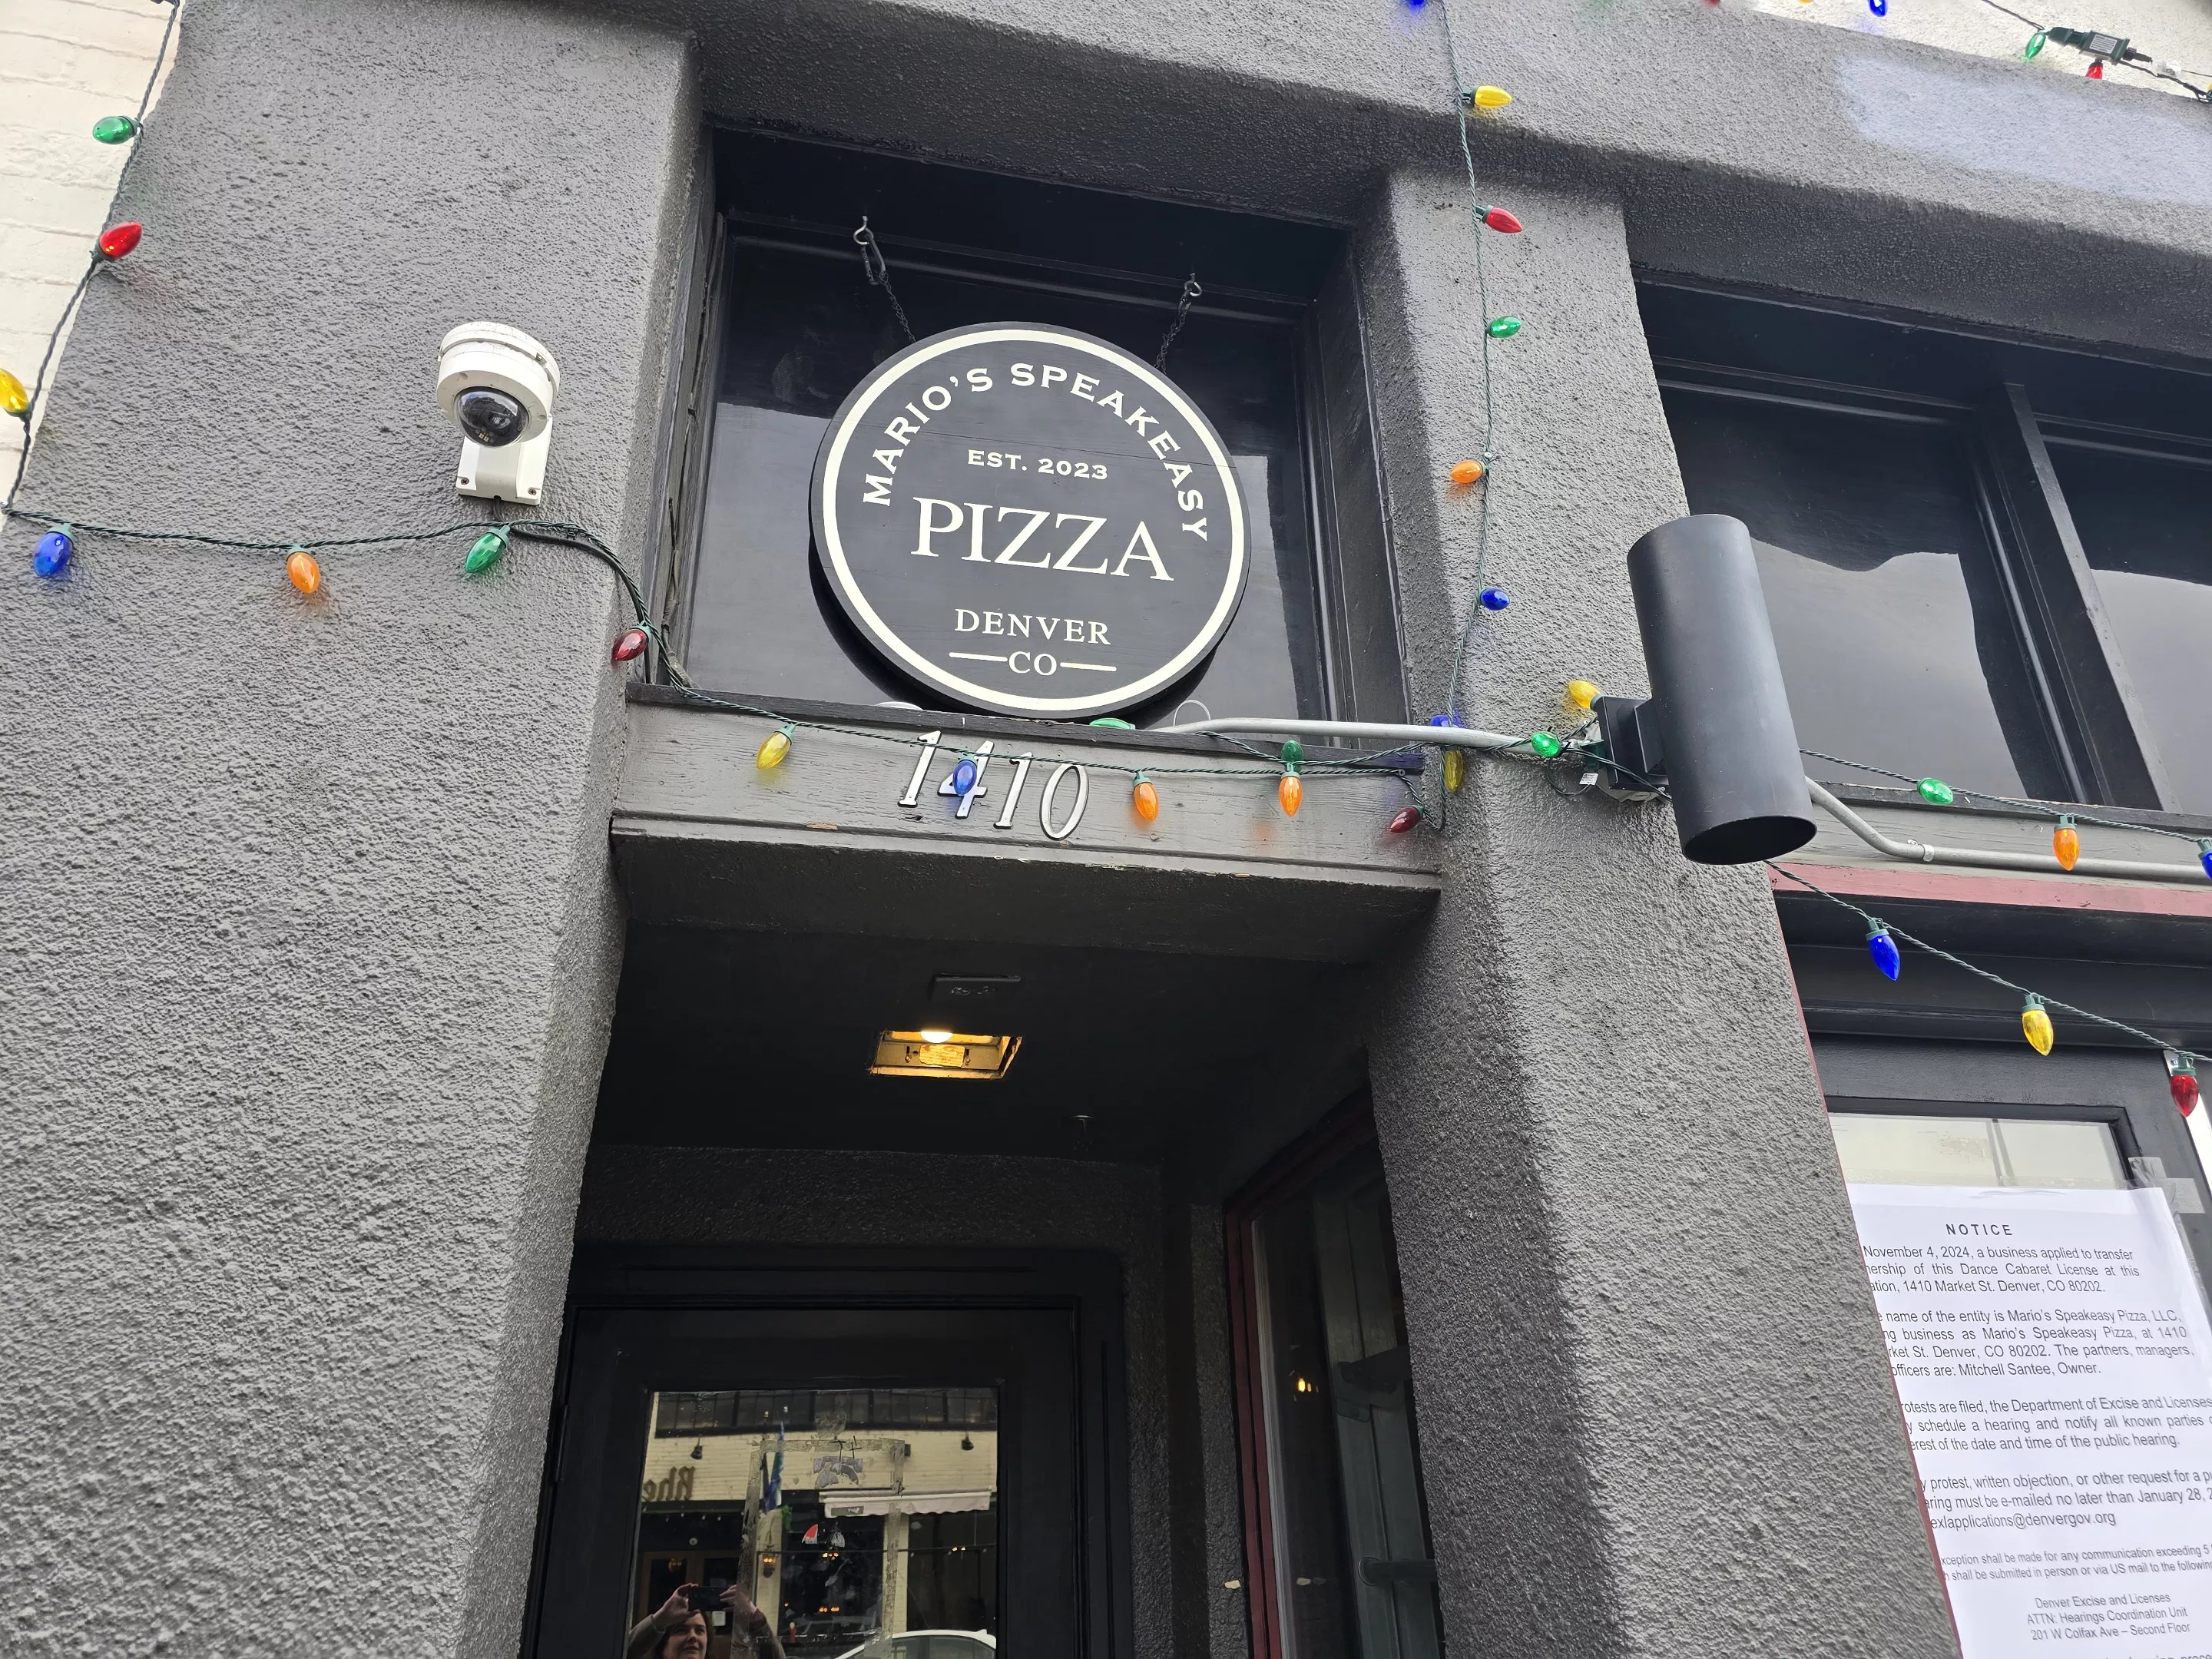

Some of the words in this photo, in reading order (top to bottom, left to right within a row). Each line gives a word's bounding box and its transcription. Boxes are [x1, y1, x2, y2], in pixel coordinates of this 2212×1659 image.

[863, 366, 993, 507] MARIO'S
[1010, 363, 1208, 542] SPEAKEASY
[967, 449, 1028, 471] EST.
[1038, 458, 1108, 480] 2023
[910, 496, 1174, 581] PIZZA
[954, 608, 1112, 645] DENVER
[1008, 651, 1058, 677] CO
[898, 730, 1090, 840] 1410
[1945, 1224, 2012, 1236] NOTICE
[1863, 1246, 1922, 1257] November
[1926, 1246, 1939, 1259] 4,
[1941, 1246, 1974, 1259] 2024,
[1976, 1249, 1985, 1258] a
[1987, 1247, 2038, 1259] business
[2040, 1247, 2079, 1260] applied
[2081, 1248, 2092, 1260] to
[2094, 1248, 2133, 1260] transfer
[1913, 1263, 1924, 1275] of
[1932, 1263, 1953, 1275] this
[1960, 1263, 1998, 1275] Dance
[2005, 1263, 2051, 1275] Cabaret
[2056, 1263, 2098, 1276] License
[2104, 1266, 2116, 1277] at
[2120, 1265, 2140, 1277] this
[1903, 1280, 1932, 1292] 1410
[1935, 1280, 1975, 1292] Market
[1979, 1280, 1995, 1292] St.
[1998, 1280, 2045, 1293] Denver,
[2047, 1280, 2065, 1292] CO
[2068, 1280, 2105, 1292] 80202.
[1886, 1312, 1918, 1322] name
[1922, 1310, 1932, 1322] of
[1936, 1310, 1955, 1322] the
[1959, 1310, 1990, 1324] entity
[1994, 1310, 2005, 1322] is
[2007, 1310, 2051, 1321] Mario's
[2055, 1310, 2114, 1323] Speakeasy
[2117, 1310, 2151, 1323] Pizza,
[2151, 1310, 2182, 1322] LLC,
[1902, 1328, 1954, 1340] business
[1962, 1330, 1976, 1340] as
[1982, 1327, 2026, 1339] Mario's
[2032, 1326, 2097, 1341] Speakeasy
[2103, 1326, 2137, 1339] Pizza,
[2141, 1327, 2153, 1338] at
[2157, 1326, 2187, 1338] 1410
[1912, 1346, 1929, 1358] St.
[1932, 1346, 1980, 1359] Denver,
[1984, 1345, 2004, 1357] CO
[2008, 1344, 2051, 1357] 80202.
[2054, 1344, 2078, 1356] The
[2083, 1344, 2133, 1358] partners,
[2135, 1345, 2194, 1358] managers,
[1933, 1365, 1956, 1376] are:
[1959, 1363, 2005, 1376] Mitchell
[2007, 1363, 2055, 1376] Santee,
[2058, 1362, 2101, 1374] Owner.
[1939, 1403, 1957, 1413] are
[1959, 1400, 1988, 1414] filed,
[1989, 1400, 2009, 1412] the
[2012, 1399, 2084, 1414] Department
[2086, 1398, 2097, 1409] of
[2099, 1397, 2138, 1410] Excise
[2141, 1396, 2164, 1409] and
[1918, 1419, 1966, 1432] schedule
[1972, 1422, 1980, 1432] a
[1984, 1418, 2030, 1433] hearing
[2036, 1417, 2059, 1430] and
[2065, 1416, 2098, 1431] notify
[2104, 1416, 2118, 1428] all
[2122, 1415, 2161, 1427] known
[2166, 1414, 2204, 1429] parties
[1939, 1438, 1949, 1450] of
[1951, 1438, 1969, 1450] the
[1972, 1437, 1996, 1450] date
[1999, 1436, 2023, 1449] and
[2025, 1435, 2052, 1449] time
[2055, 1435, 2068, 1448] of
[2071, 1435, 2091, 1447] the
[2094, 1434, 2131, 1449] public
[2132, 1432, 2180, 1449] hearing.
[1930, 1476, 1972, 1492] protest,
[1973, 1475, 2010, 1488] written
[2013, 1473, 2073, 1490] objection,
[2076, 1474, 2088, 1485] or
[2092, 1472, 2124, 1485] other
[2128, 1470, 2173, 1486] request
[2174, 1469, 2190, 1482] for
[2193, 1472, 2201, 1482] a
[1955, 1495, 1983, 1508] must
[1985, 1495, 1998, 1508] be
[2002, 1492, 2052, 1507] e-mailed
[2057, 1494, 2072, 1505] no
[2075, 1492, 2103, 1505] later
[2106, 1490, 2134, 1504] than
[2138, 1489, 2183, 1504] January
[2186, 1488, 2206, 1502] 28,
[1981, 1552, 2003, 1564] shall
[2004, 1552, 2016, 1563] be
[2018, 1551, 2041, 1563] made
[2044, 1551, 2057, 1561] for
[2061, 1551, 2078, 1564] any
[2081, 1547, 2154, 1561] communication
[2156, 1545, 2202, 1558] exceeding
[1952, 1570, 1973, 1581] shall
[1975, 1569, 1987, 1580] be
[1989, 1568, 2032, 1579] submitted
[2033, 1567, 2043, 1578] in
[2045, 1566, 2078, 1579] person
[2081, 1567, 2091, 1576] or
[2094, 1564, 2108, 1575] via
[2110, 1563, 2126, 1575] US
[2128, 1561, 2149, 1573] mail
[2149, 1562, 2159, 1572] to
[2161, 1561, 2176, 1571] the
[2035, 1598, 2070, 1608] Denver
[2072, 1594, 2106, 1607] Excise
[2109, 1594, 2128, 1606] and
[2128, 1592, 2171, 1604] Licenses
[2028, 1613, 2058, 1625] ATTN:
[2060, 1611, 2105, 1624] Hearings
[2107, 1608, 2167, 1621] Coordination
[2168, 1607, 2188, 1618] Unit
[2031, 1629, 2049, 1641] 201
[2051, 1628, 2061, 1640] W
[2065, 1627, 2096, 1639] Colfax
[2100, 1626, 2119, 1637] Ave
[2130, 1624, 2166, 1635] Second
[2167, 1622, 2190, 1633] Floor
